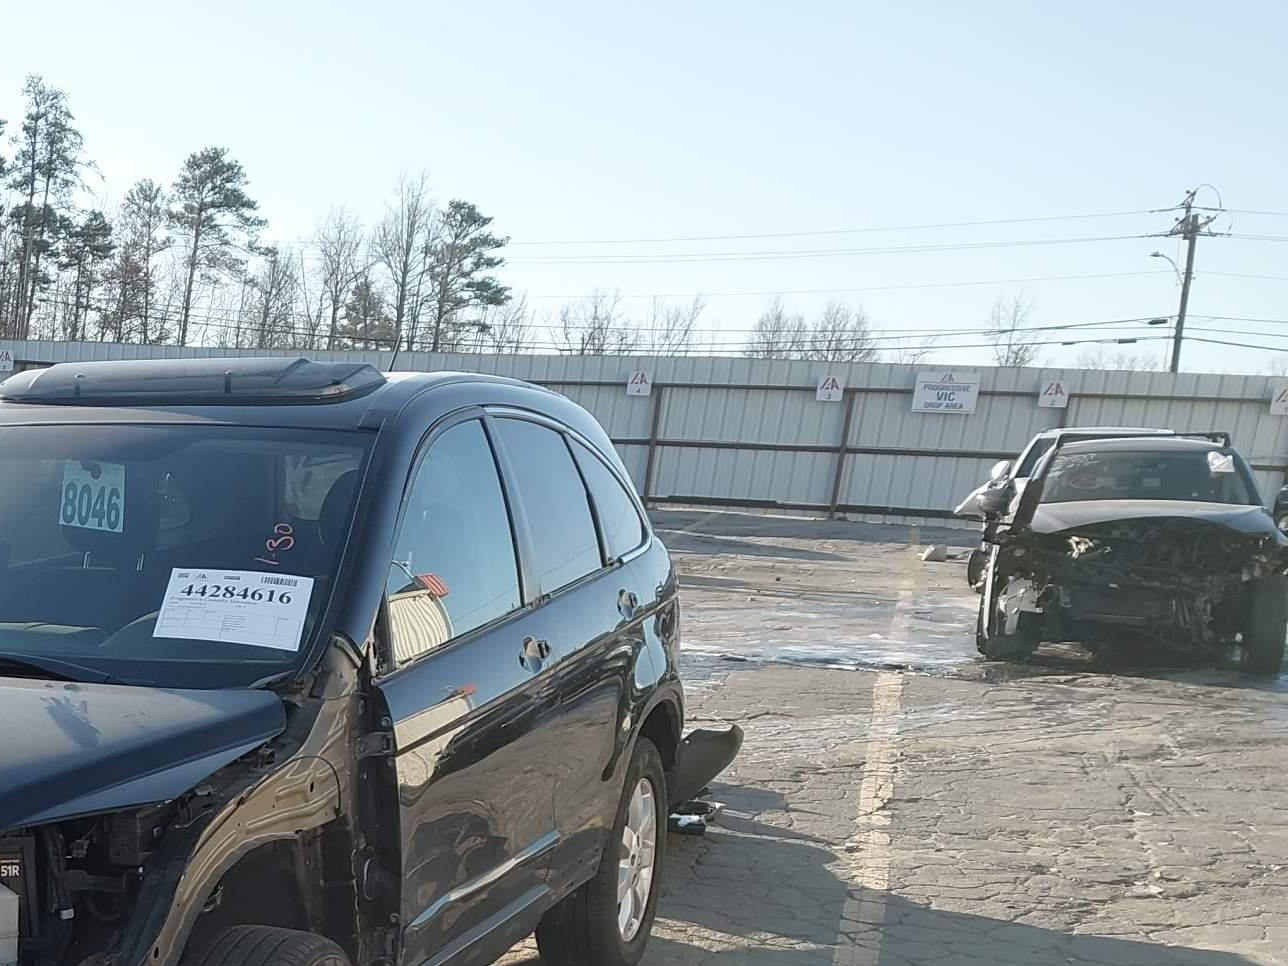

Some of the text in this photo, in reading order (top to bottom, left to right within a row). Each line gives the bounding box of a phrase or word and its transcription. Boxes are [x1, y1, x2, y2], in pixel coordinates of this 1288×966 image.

[936, 391, 956, 402] VIC
[62, 481, 121, 530] 8046
[180, 583, 293, 605] 44284616
[0, 864, 20, 877] 51R
